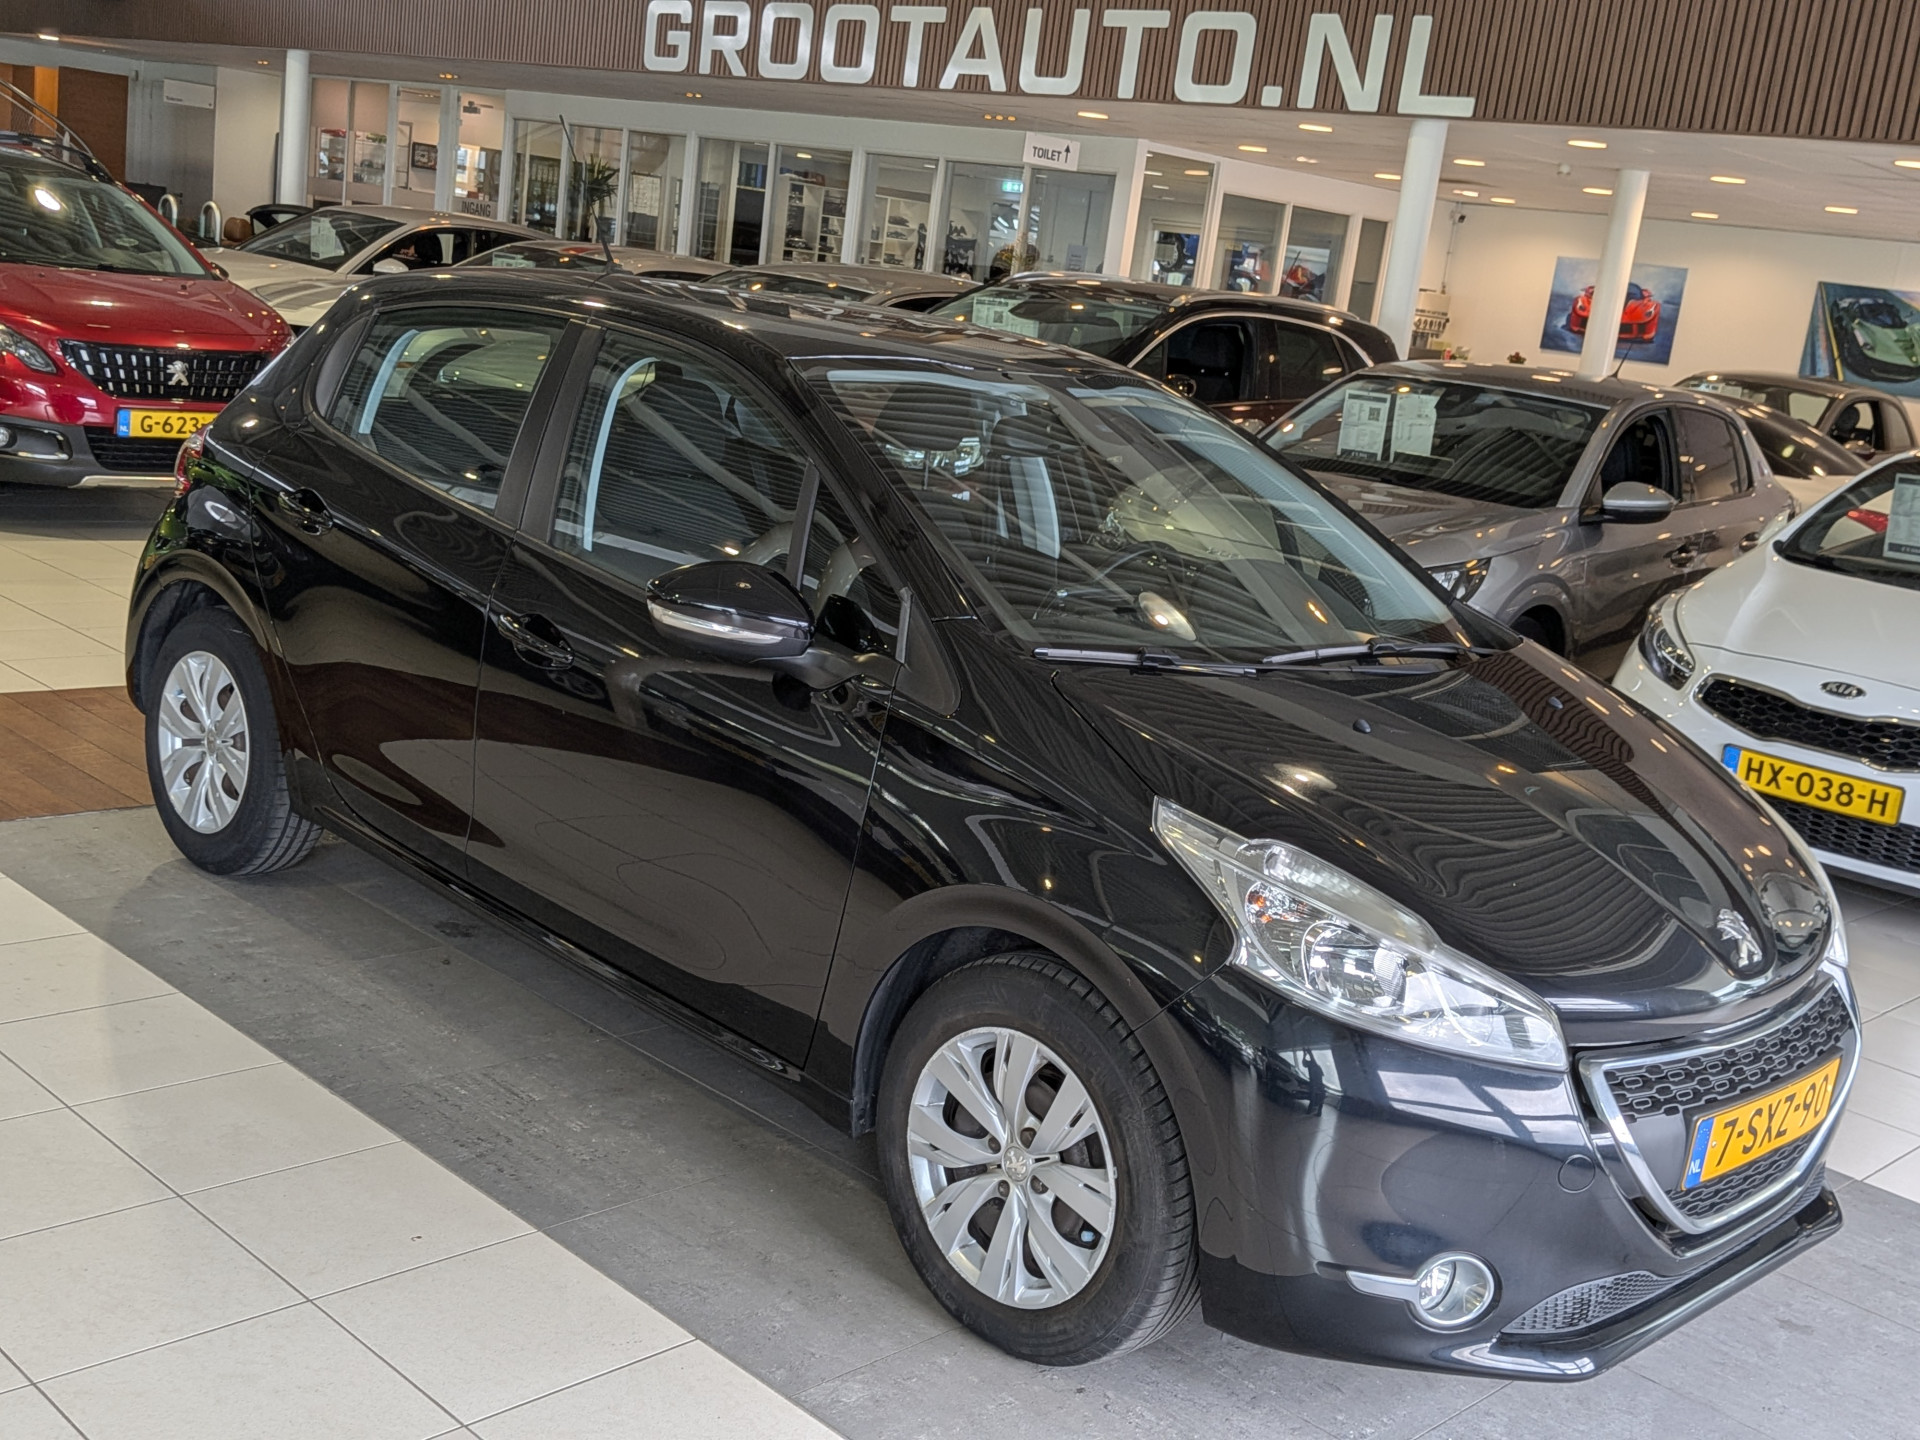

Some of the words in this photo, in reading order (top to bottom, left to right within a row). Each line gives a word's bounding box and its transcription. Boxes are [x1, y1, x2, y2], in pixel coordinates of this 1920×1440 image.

[643, 0, 1476, 118] GROOTAUTO.NL
[1032, 145, 1062, 162] TOILET
[461, 200, 491, 217] INGANG
[1825, 682, 1858, 697] KIA
[1744, 757, 1890, 817] HX-038-H
[1716, 1073, 1829, 1167] 7-SXZ-90
[1688, 1159, 1701, 1175] NL
